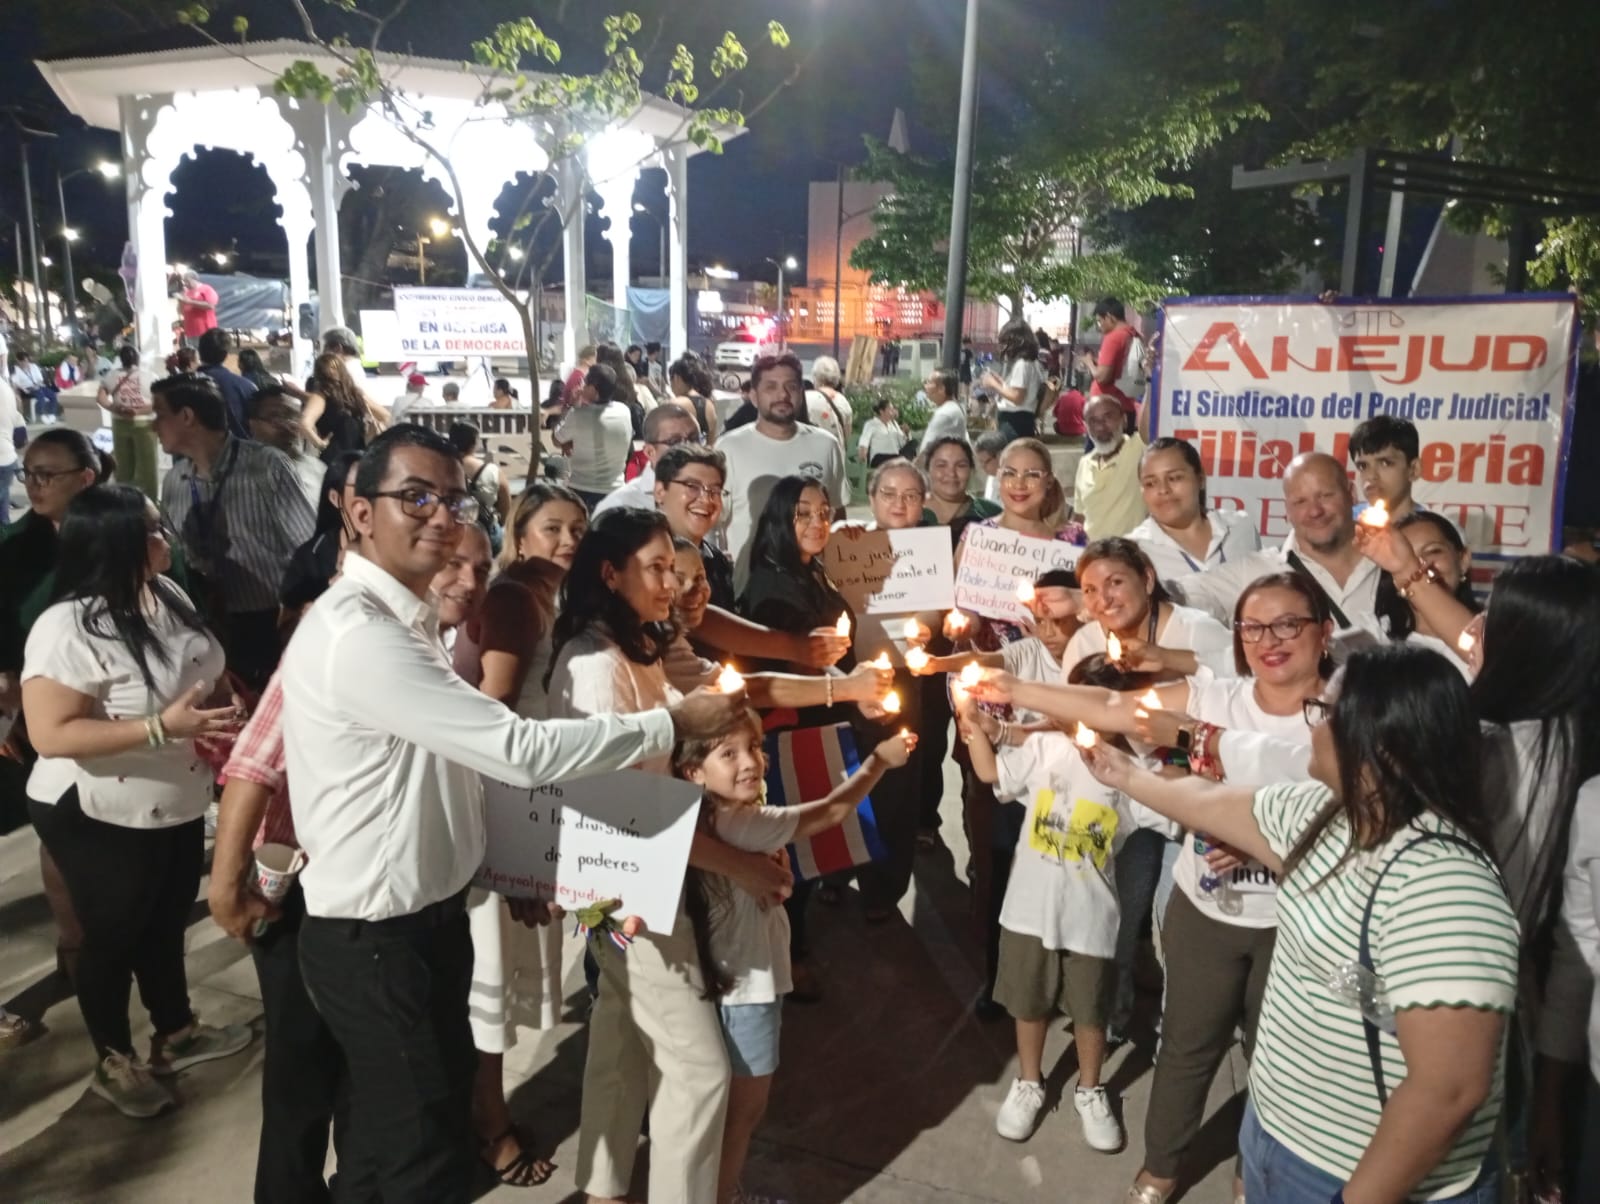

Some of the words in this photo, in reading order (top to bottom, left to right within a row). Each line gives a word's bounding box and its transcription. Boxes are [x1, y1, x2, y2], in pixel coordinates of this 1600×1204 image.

[419, 321, 438, 333] EN
[402, 339, 418, 350] DE
[423, 339, 440, 350] LA
[445, 340, 528, 351] DEMOCRACI
[1171, 390, 1191, 417] El
[1197, 390, 1315, 418] Sindicato
[1321, 392, 1362, 419] del
[1368, 392, 1444, 420] Poder
[1448, 393, 1551, 421] Judicial
[1333, 432, 1545, 487] Leria
[837, 544, 857, 562] La
[969, 527, 1027, 557] Cuando
[1032, 546, 1046, 562] el
[926, 563, 938, 576] el
[1011, 565, 1042, 580] cont
[500, 780, 564, 803] peto
[551, 808, 565, 825] la
[544, 846, 562, 863] de
[577, 852, 640, 873] poderes
